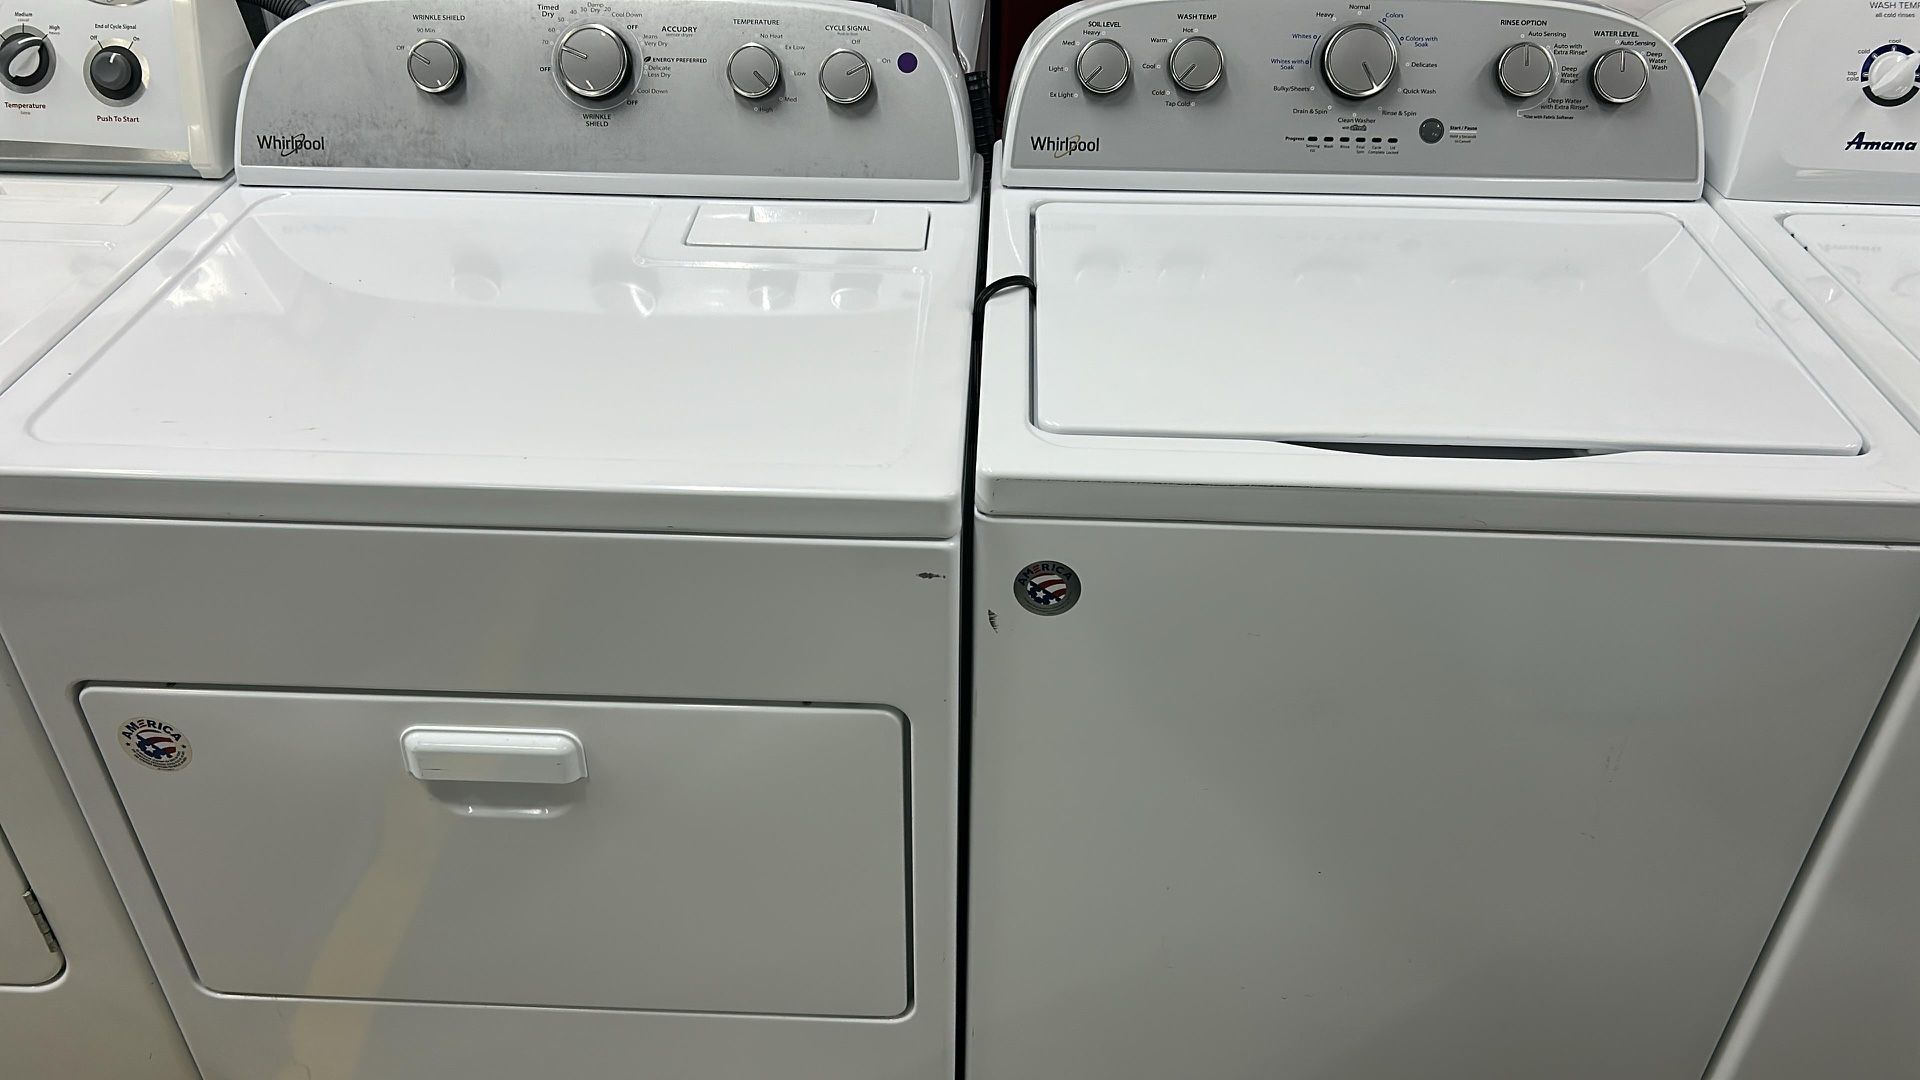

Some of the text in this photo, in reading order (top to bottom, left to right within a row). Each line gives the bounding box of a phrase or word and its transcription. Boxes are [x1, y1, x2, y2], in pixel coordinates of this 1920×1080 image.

[4, 102, 46, 110] Temperature
[256, 134, 325, 154] Whirlpool
[1031, 136, 1099, 155] Whirlpool
[1845, 132, 1917, 150] Amana
[1018, 564, 1073, 586] AMERICA
[122, 719, 182, 741] AMERICA
